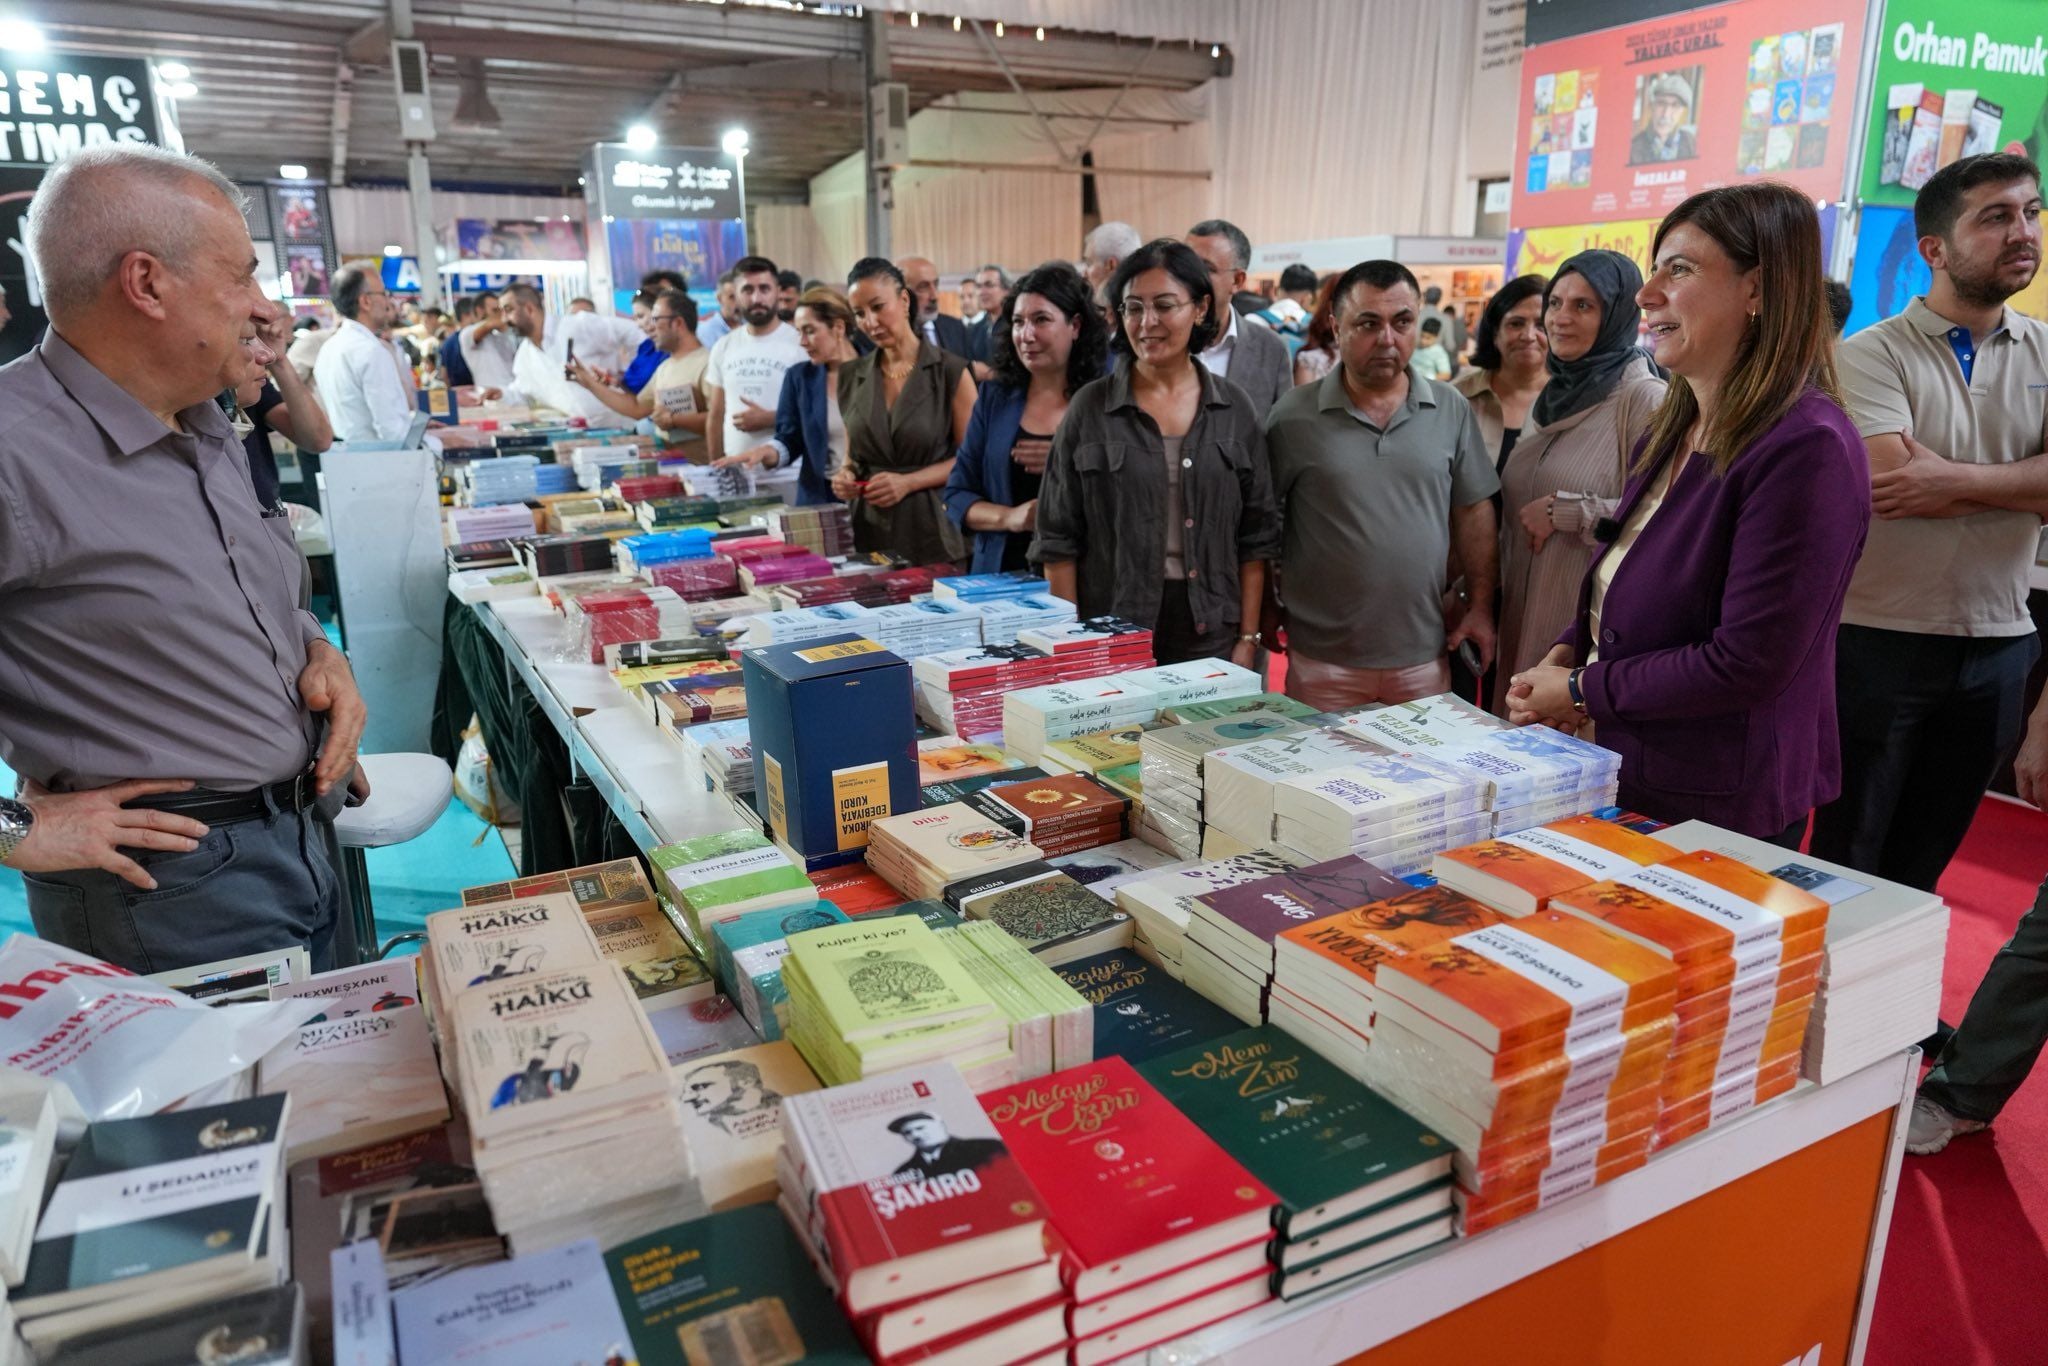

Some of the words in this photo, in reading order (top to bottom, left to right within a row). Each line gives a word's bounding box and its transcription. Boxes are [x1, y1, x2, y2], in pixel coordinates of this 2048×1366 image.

[1683, 33, 1718, 52] URAL
[1894, 21, 1966, 68] Orhan
[1971, 32, 2048, 76] Pamuk
[736, 368, 772, 377] JEANS
[840, 795, 868, 812] KURDÎ
[841, 804, 887, 822] EDEBIYATA
[912, 814, 949, 826] Dilşa
[740, 852, 778, 864] BILIND
[969, 880, 1005, 894] GULDAN
[817, 935, 859, 949] Kujer
[864, 930, 877, 940] ki
[882, 928, 907, 939] ye?
[293, 975, 389, 998] NEXWEŞXANE
[1078, 966, 1147, 1006] eyran
[1171, 1043, 1272, 1080] Mem
[872, 1168, 982, 1221] ŞAKIRO
